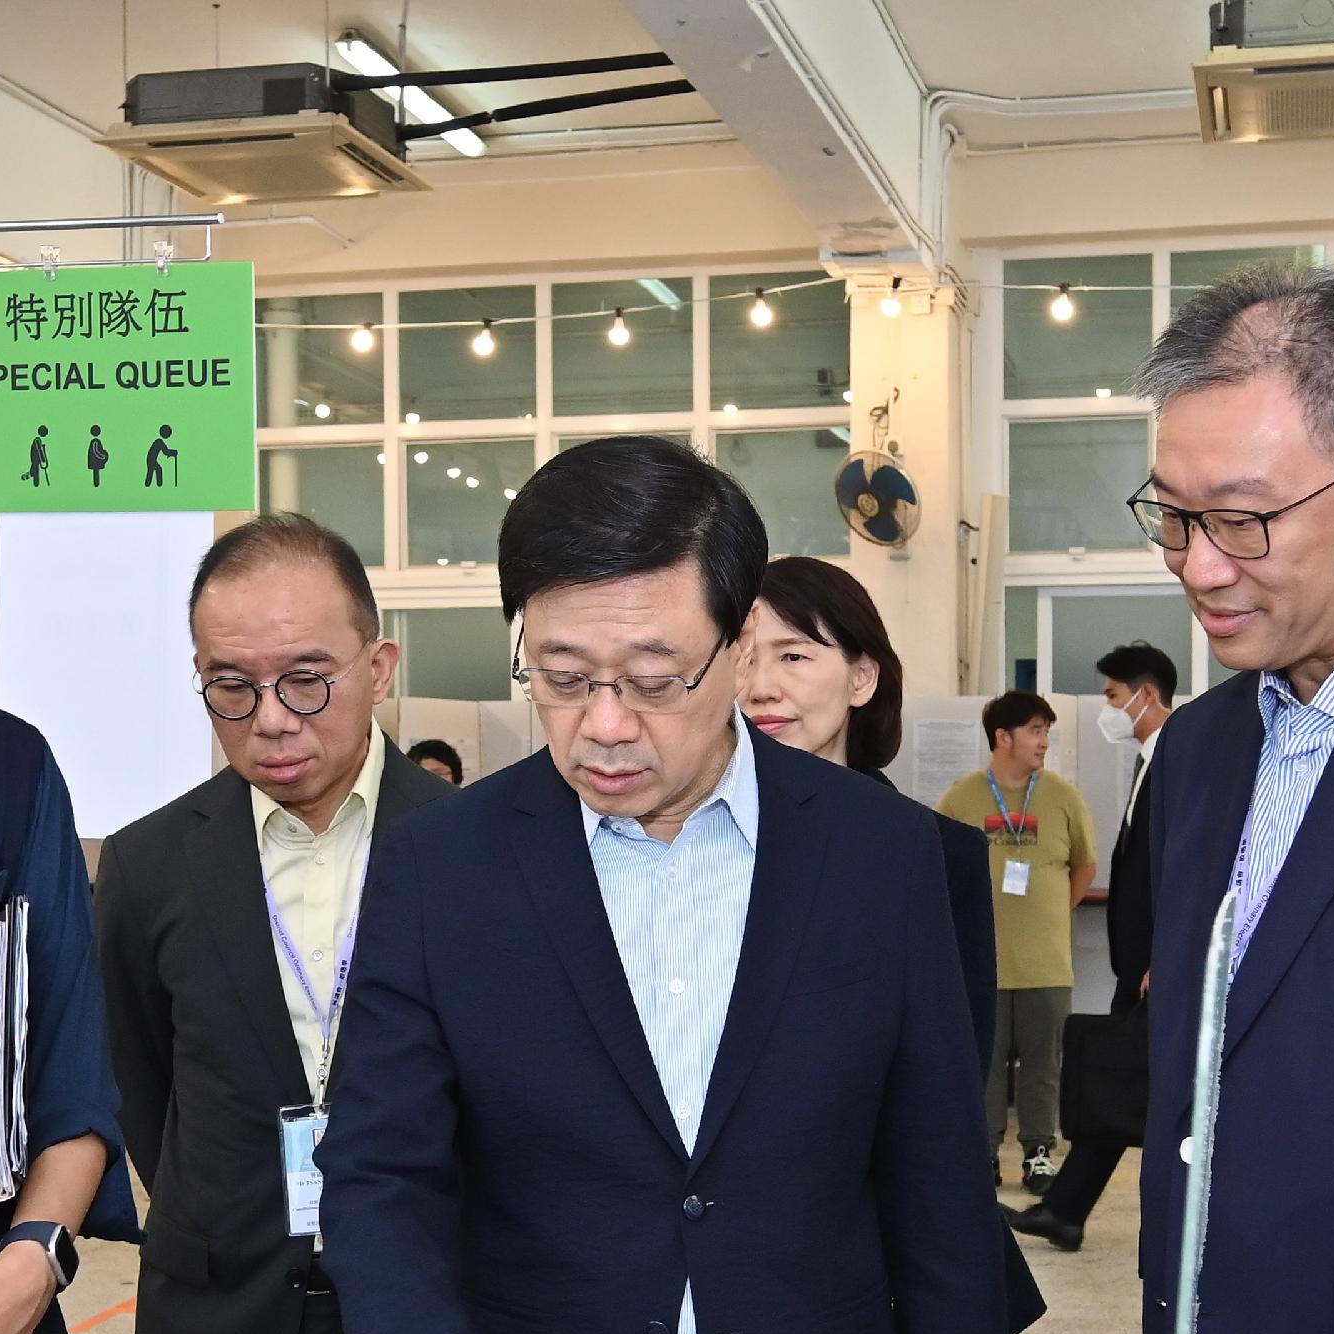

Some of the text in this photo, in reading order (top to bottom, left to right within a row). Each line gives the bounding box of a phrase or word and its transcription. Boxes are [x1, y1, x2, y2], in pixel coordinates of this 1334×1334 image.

[5, 287, 189, 342] 特別隊伍
[115, 357, 231, 390] QUEUE
